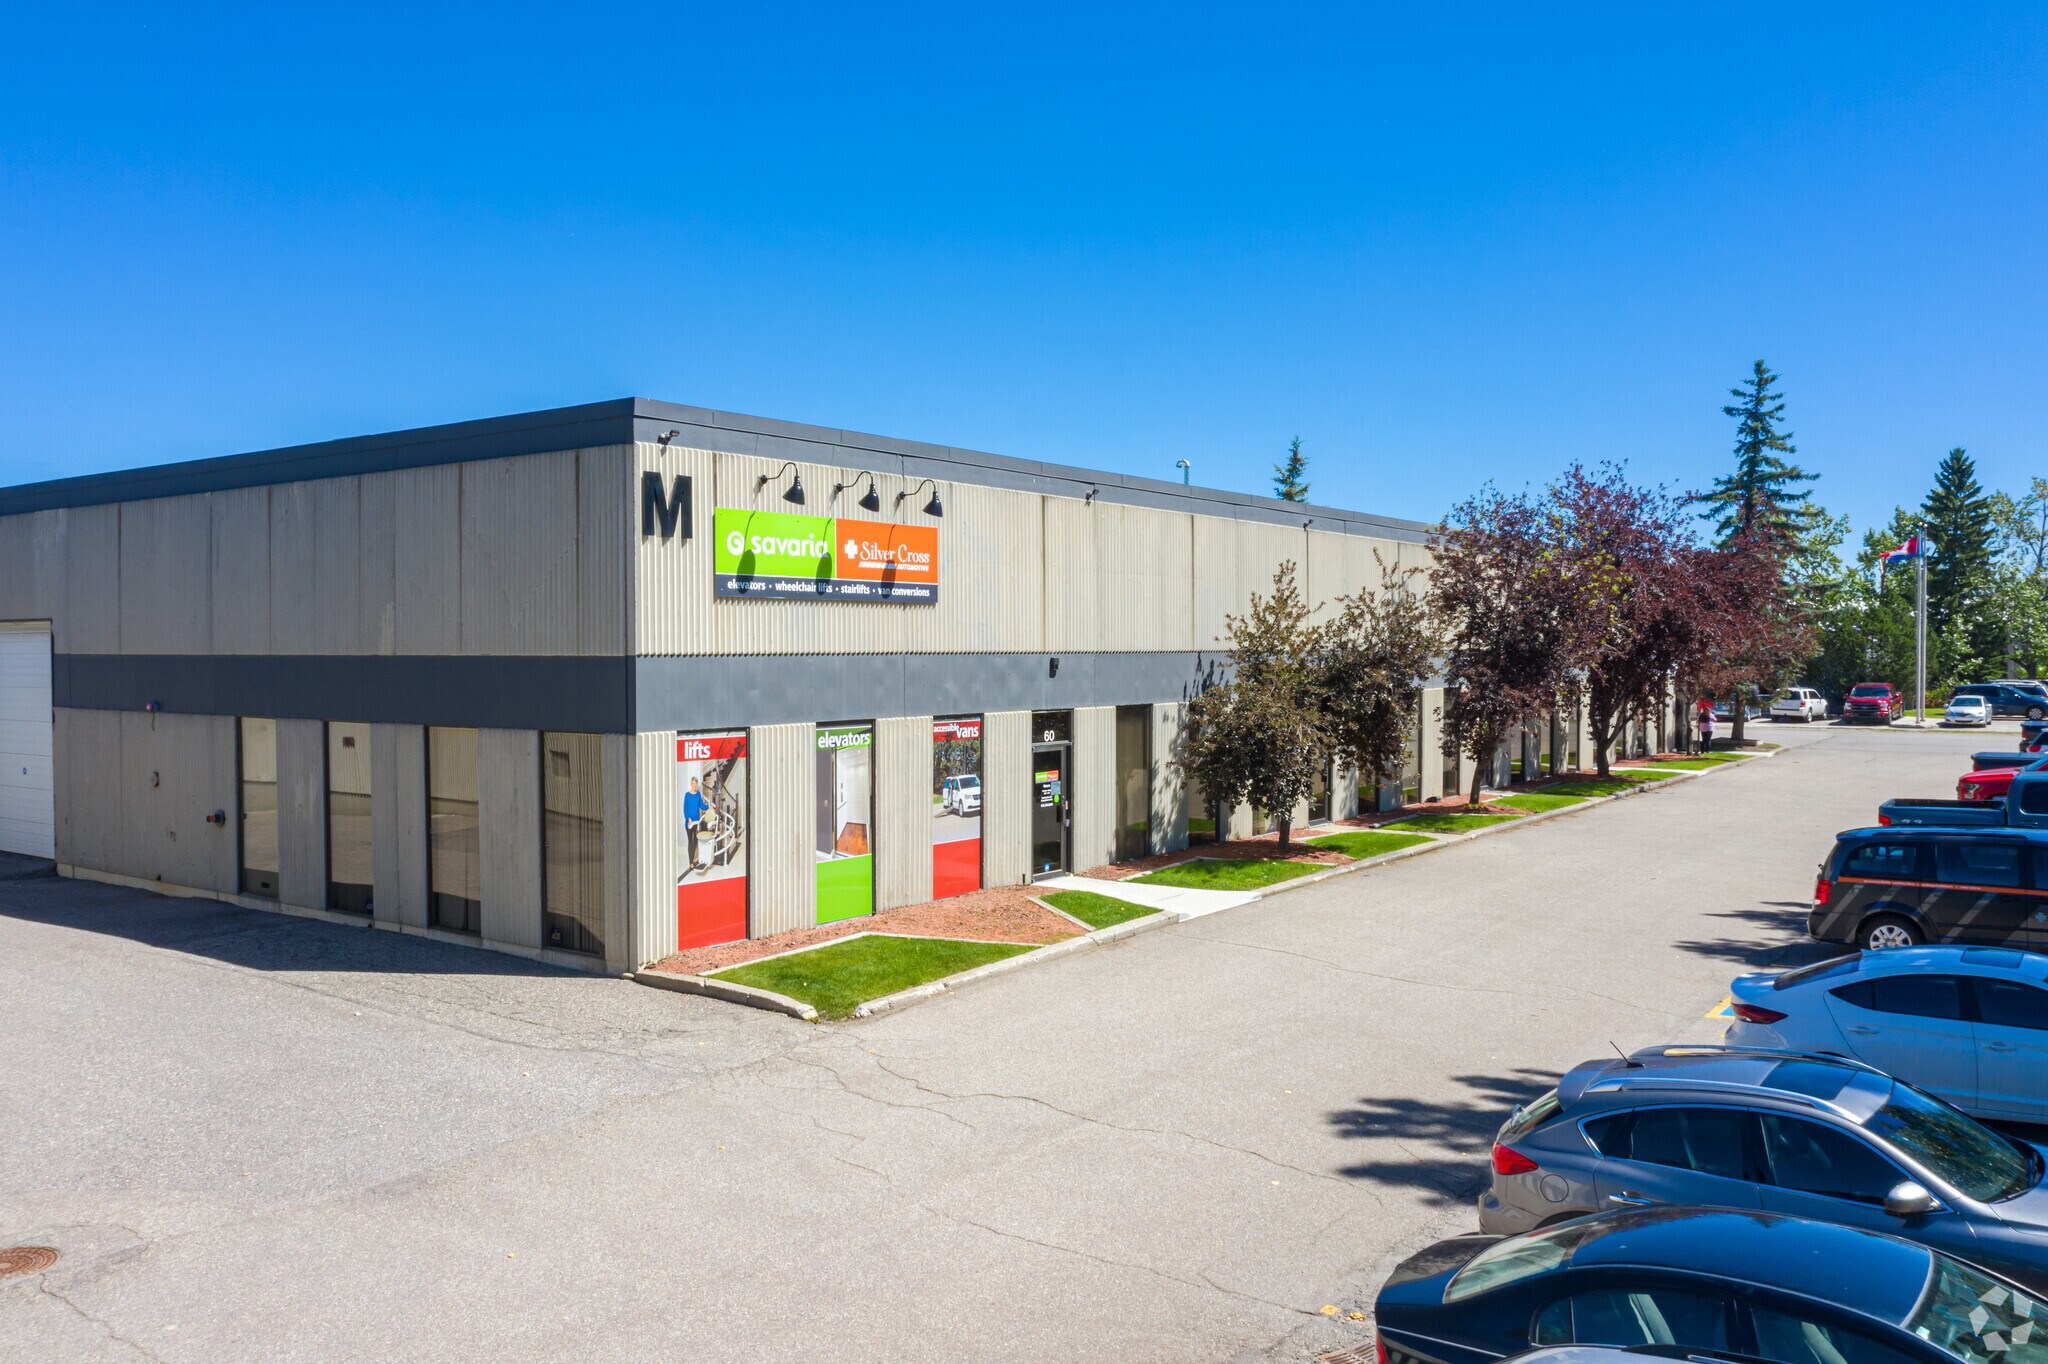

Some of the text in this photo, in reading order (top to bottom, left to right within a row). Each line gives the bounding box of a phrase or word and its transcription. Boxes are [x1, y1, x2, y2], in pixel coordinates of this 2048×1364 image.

[641, 471, 693, 539] M
[751, 533, 829, 558] savaria
[859, 540, 930, 563] Silver Cross
[897, 564, 930, 572] AUTOMOTIVE
[727, 578, 930, 597] elevators wheelchair lifts stairlifts van conversions
[933, 723, 959, 733] accessible
[956, 726, 979, 739] vans
[1044, 730, 1055, 742] 60
[818, 731, 871, 748] elevators
[684, 741, 711, 760] lifts
